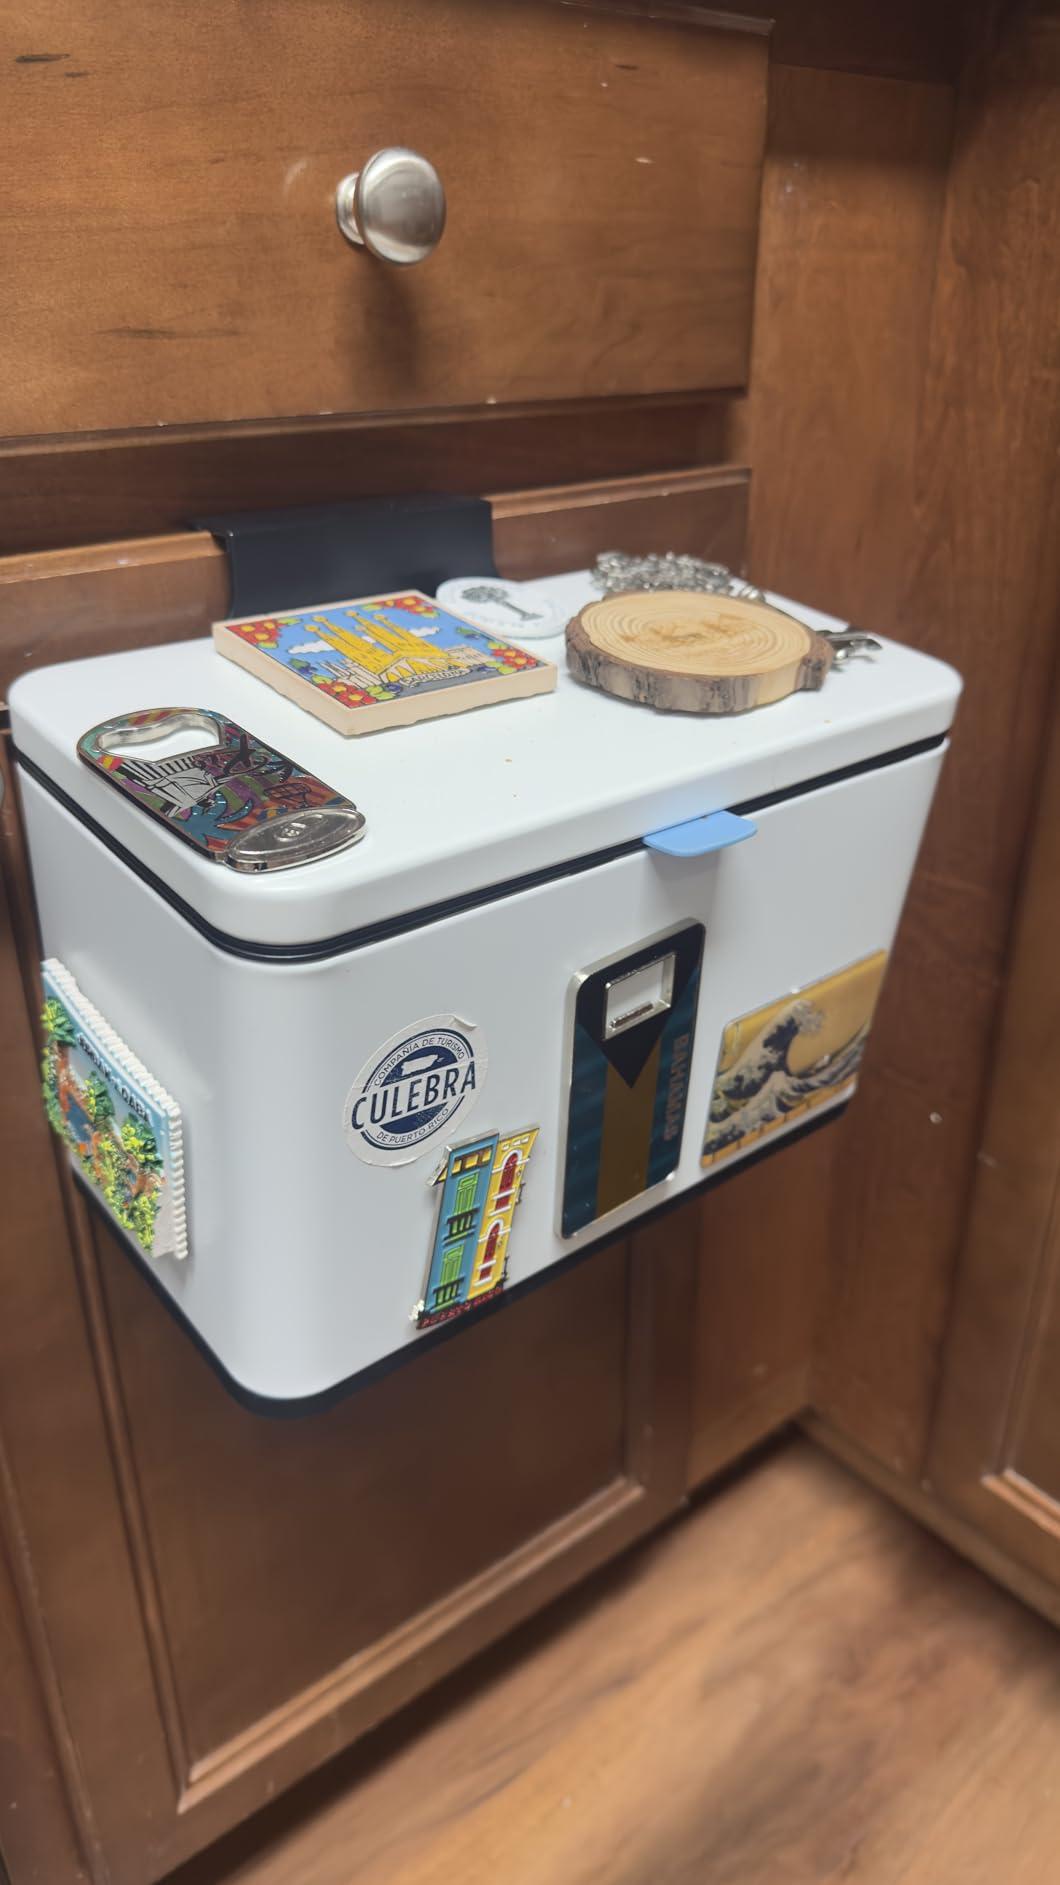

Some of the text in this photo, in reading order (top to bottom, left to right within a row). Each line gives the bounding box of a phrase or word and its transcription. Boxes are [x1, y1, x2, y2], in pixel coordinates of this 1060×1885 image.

[421, 1037, 435, 1047] DE
[437, 1037, 465, 1060] TURISMO
[351, 1060, 476, 1130] CULEBRA
[376, 1108, 449, 1143] DE PUERTO RICO
